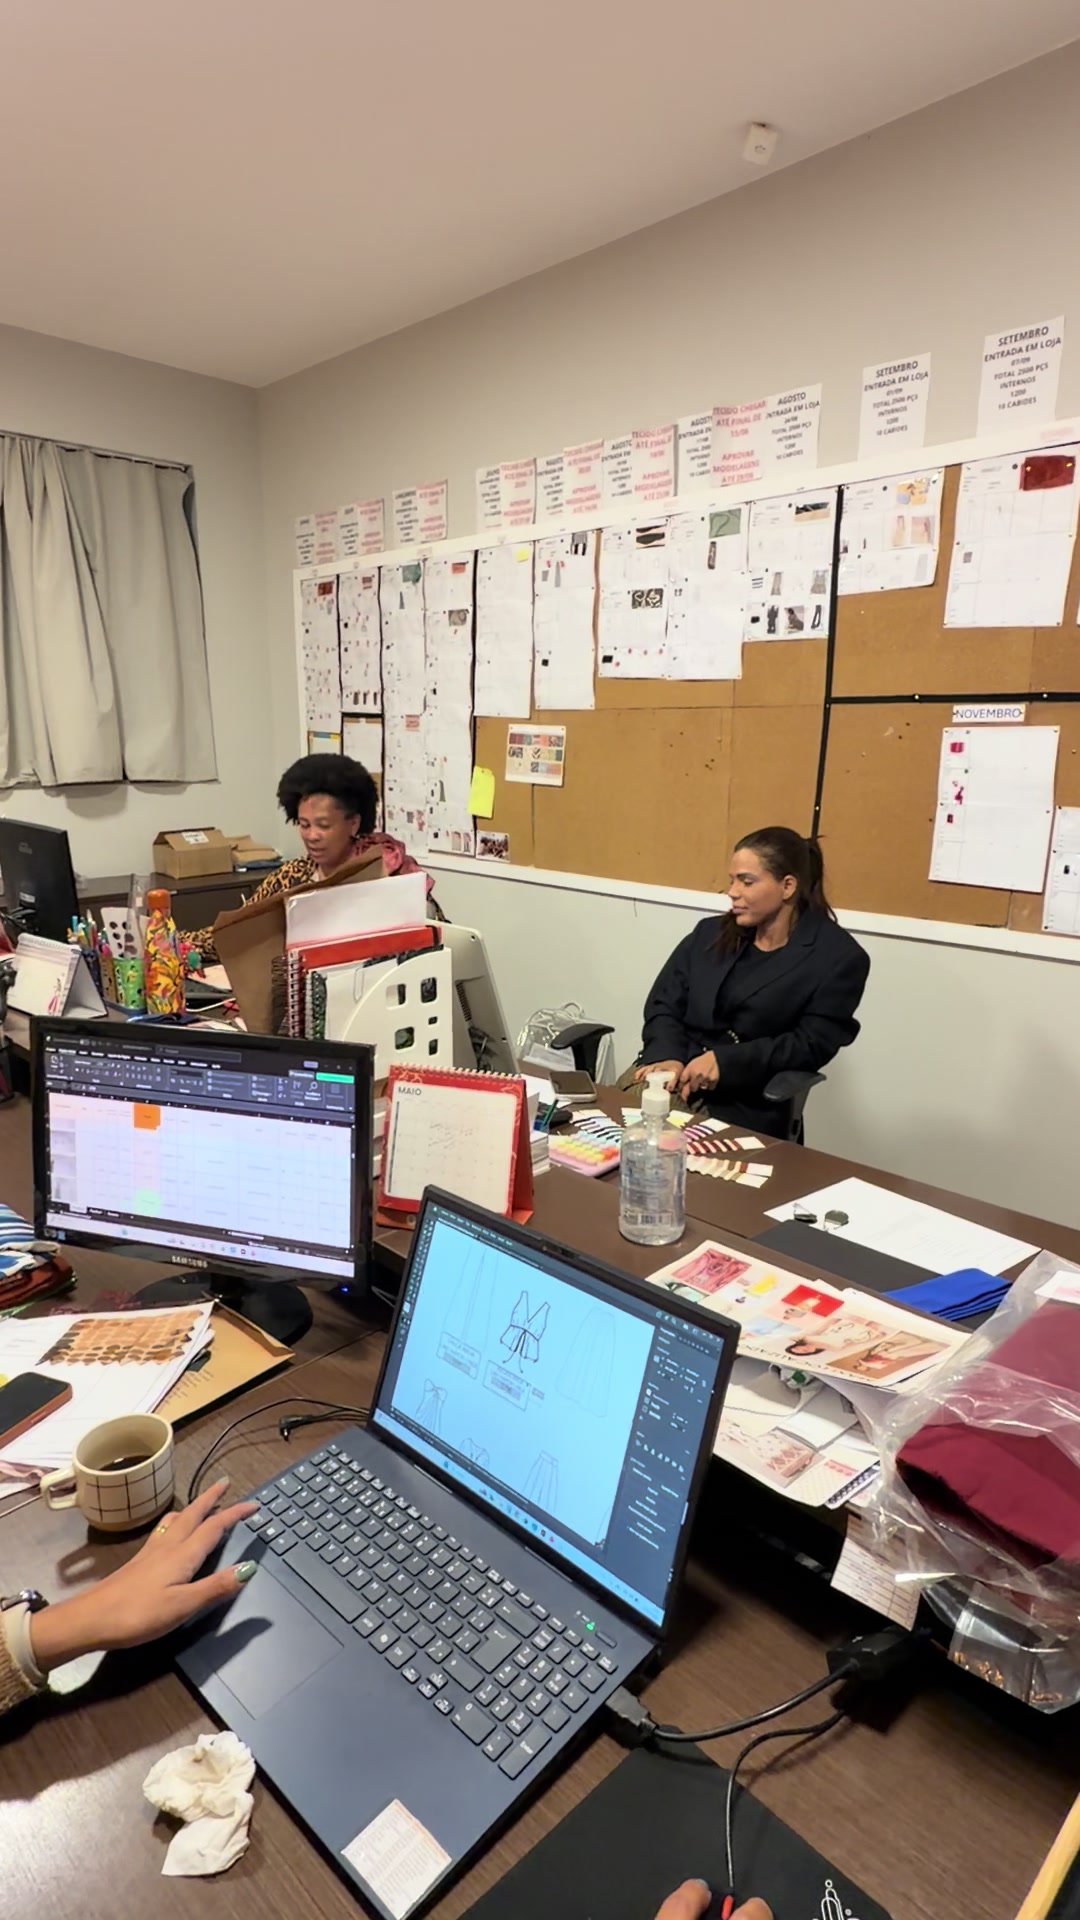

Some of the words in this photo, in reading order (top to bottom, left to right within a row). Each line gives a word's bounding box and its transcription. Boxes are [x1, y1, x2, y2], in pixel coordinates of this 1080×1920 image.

[998, 326, 1049, 347] SETEMBRO
[984, 346, 1023, 362] ENTRADA
[1025, 342, 1039, 353] EM
[1040, 337, 1061, 349] LOJA
[876, 360, 918, 378] SETEMBRO
[994, 371, 1015, 380] TOTAL
[864, 378, 896, 392] ENTRADA
[898, 375, 910, 384] EM
[911, 371, 929, 381] LOJA
[1000, 376, 1036, 389] INTERNOS
[777, 392, 806, 406] AGOSTO
[1007, 396, 1037, 409] CABIDES
[712, 406, 738, 416] TECIDO
[793, 404, 804, 413] EM
[956, 708, 1021, 718] NOVEMBRO
[398, 1087, 422, 1096] MAIO
[172, 1255, 208, 1269] SAMSUNG
